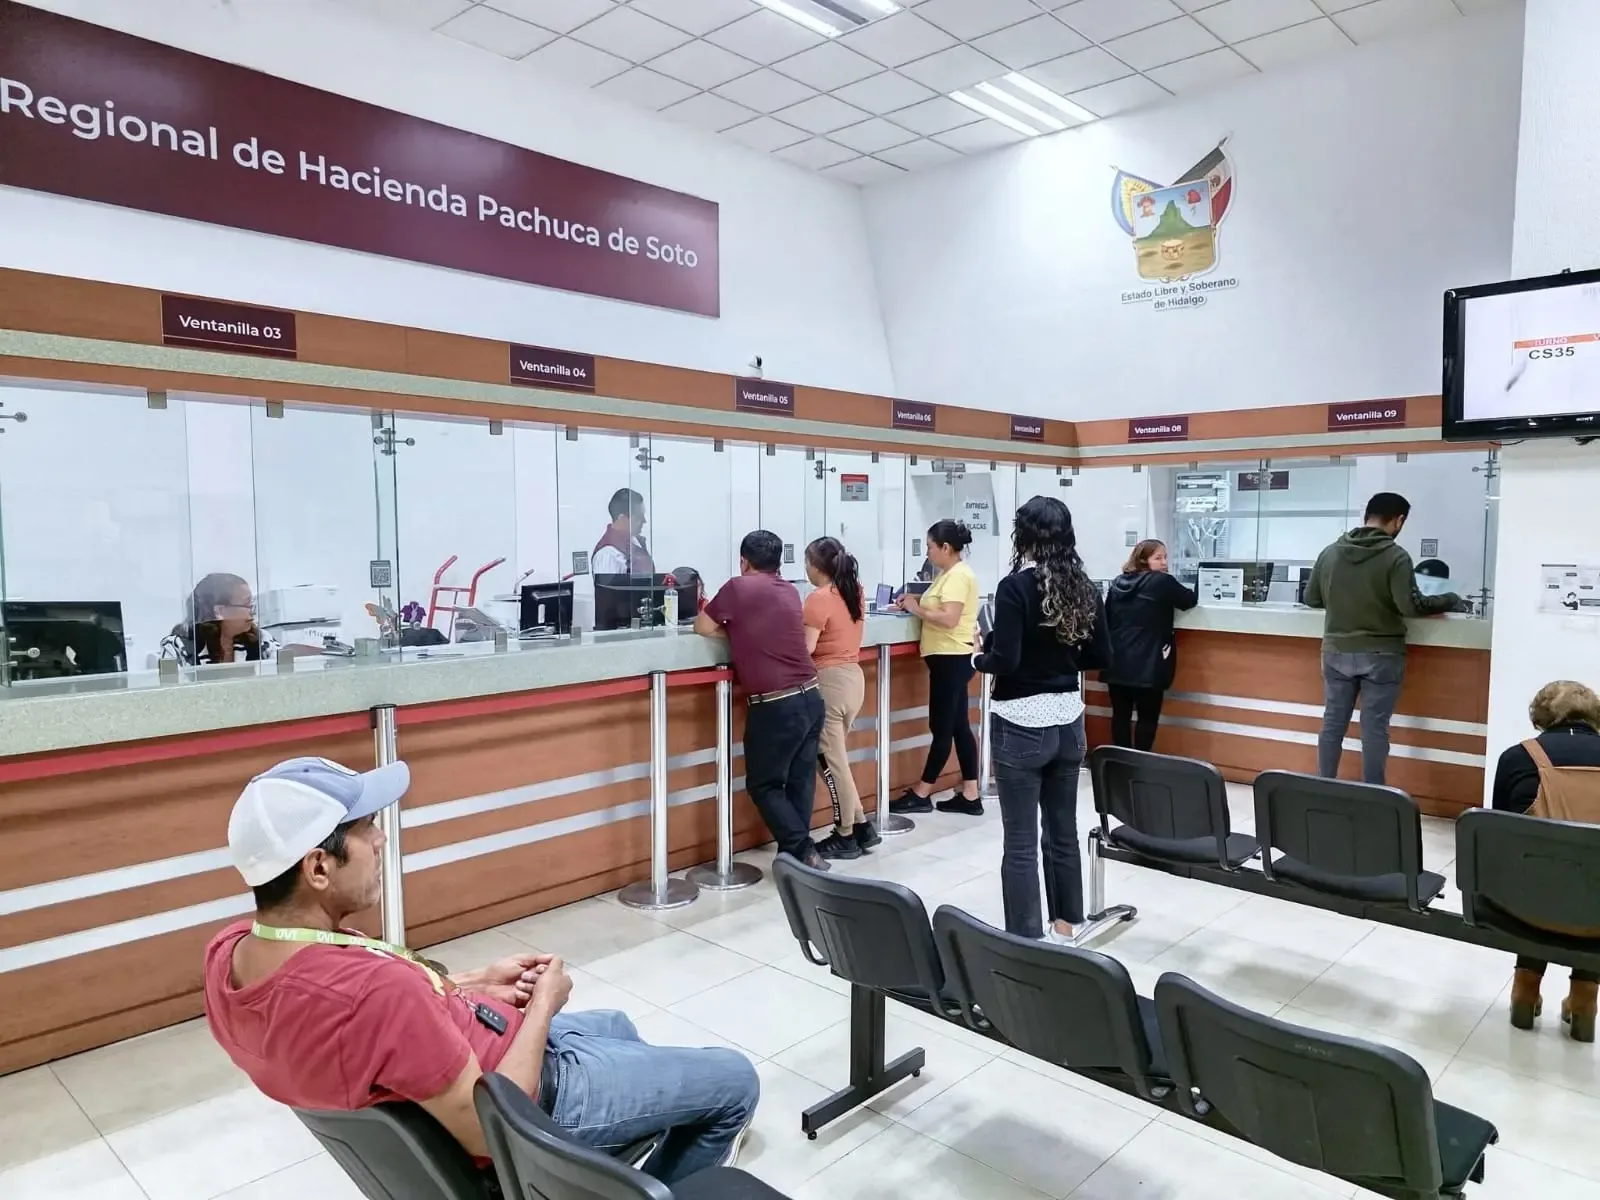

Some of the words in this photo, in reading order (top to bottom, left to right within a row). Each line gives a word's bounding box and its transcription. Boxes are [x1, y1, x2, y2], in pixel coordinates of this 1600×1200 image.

[0, 77, 218, 160] Regional
[233, 137, 285, 174] de
[299, 151, 467, 217] Hacienda
[478, 194, 600, 247] Pachuca
[608, 227, 640, 255] de
[646, 236, 698, 268] Soto
[1121, 290, 1153, 302] Estado
[1154, 287, 1178, 297] Libre
[1181, 285, 1187, 294] y
[1188, 278, 1236, 291] Soberano
[1154, 300, 1166, 309] de
[1168, 296, 1205, 307] Hidalgo
[179, 314, 260, 337] Ventanilla
[263, 326, 282, 340] 03
[1528, 346, 1574, 360] CS35
[519, 359, 571, 377] Ventanilla
[572, 367, 587, 378] 04
[742, 390, 778, 403] Ventanilla
[779, 396, 789, 405] 05
[897, 410, 924, 421] Ventanilla
[923, 414, 932, 422] 06
[1336, 410, 1383, 421] Ventanilla
[1384, 409, 1397, 418] 09
[1014, 425, 1035, 434] Ventanilla
[1134, 425, 1171, 434] Ventanilla
[1171, 424, 1182, 432] 08
